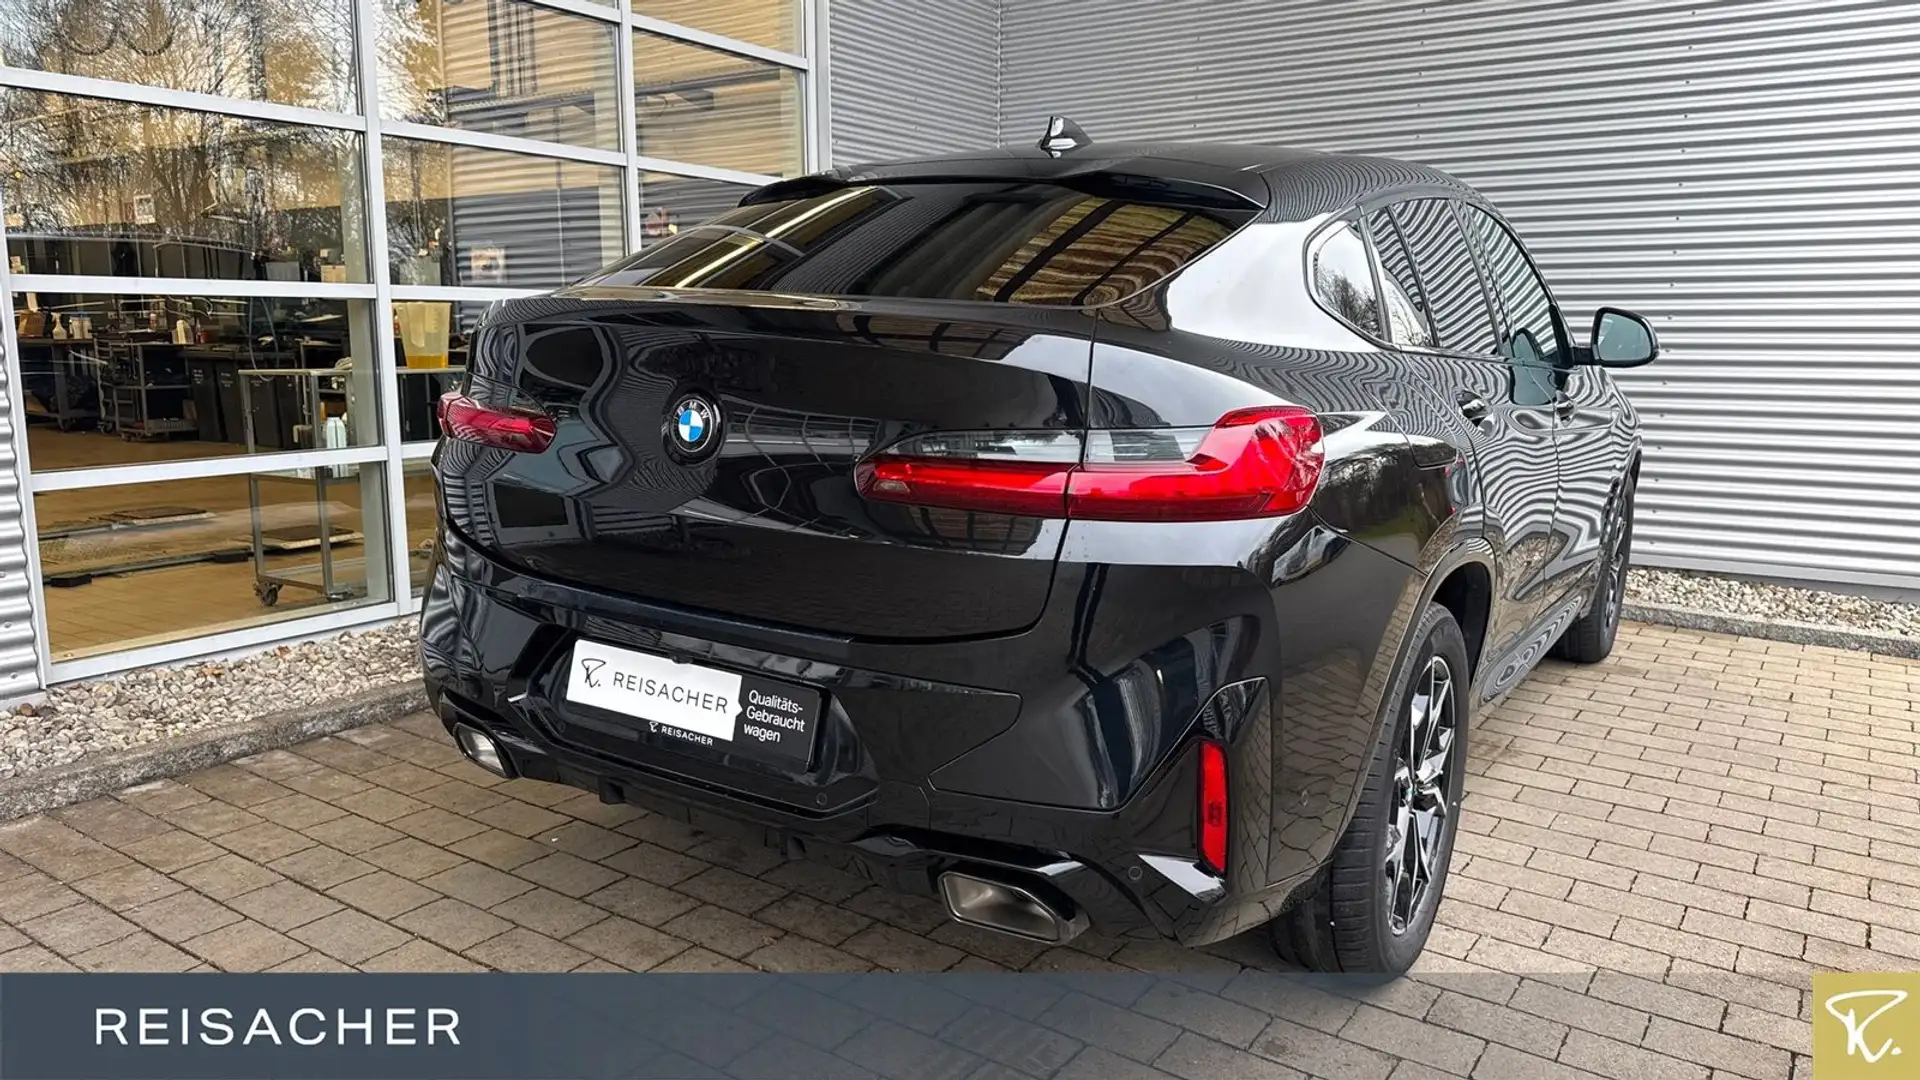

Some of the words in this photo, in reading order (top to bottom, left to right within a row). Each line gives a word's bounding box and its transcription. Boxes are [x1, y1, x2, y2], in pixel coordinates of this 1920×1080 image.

[677, 401, 709, 419] BMW
[613, 671, 727, 713] REISACHER
[748, 689, 803, 714] Qualitäts-
[746, 705, 805, 732] Gebraucht
[661, 725, 713, 747] REISACHER
[744, 722, 780, 743] wagen
